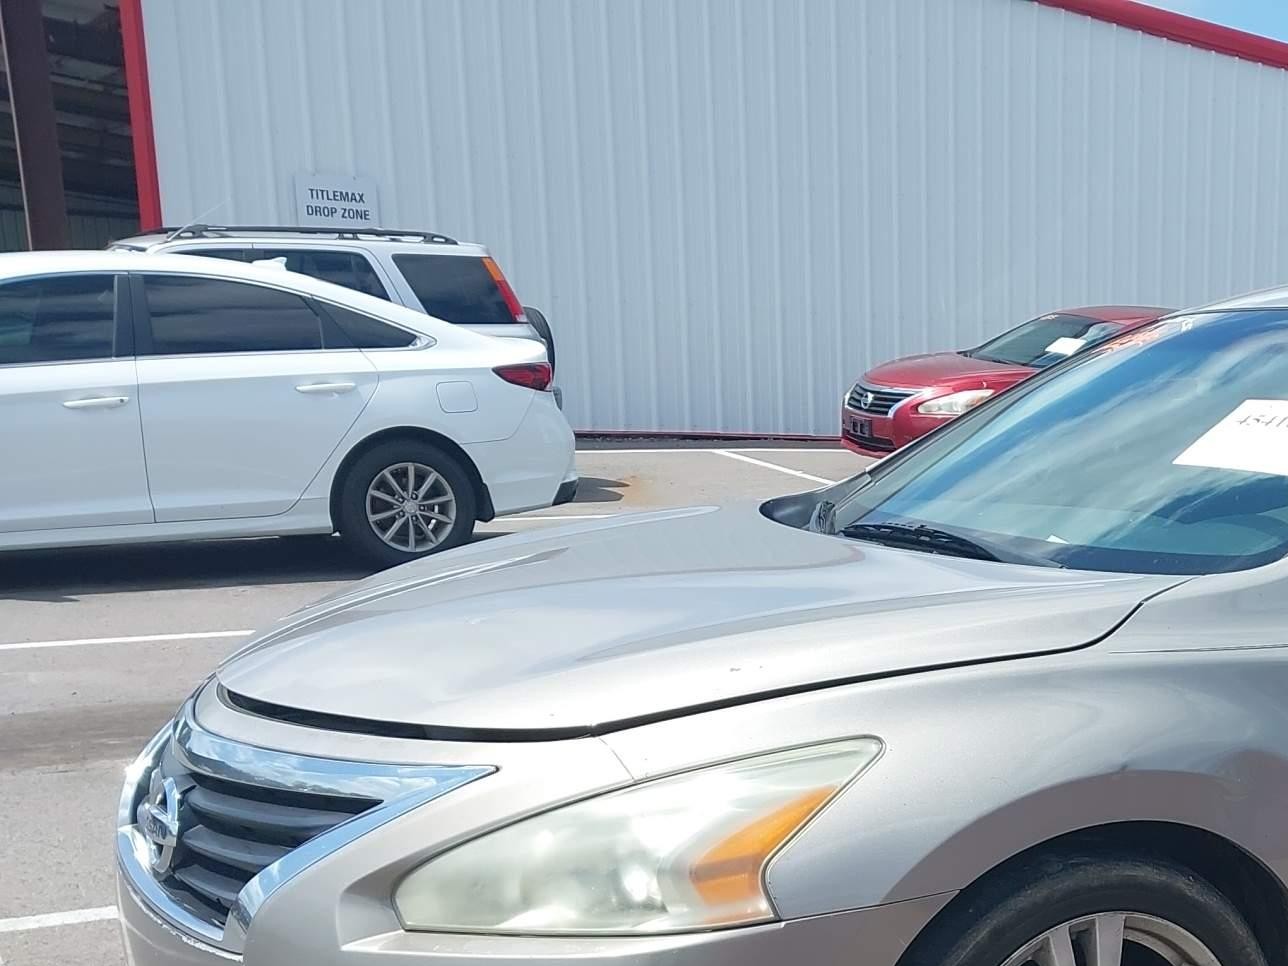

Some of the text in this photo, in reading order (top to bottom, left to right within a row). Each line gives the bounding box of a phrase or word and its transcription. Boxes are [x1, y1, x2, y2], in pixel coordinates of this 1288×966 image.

[308, 188, 365, 203] TITLEMAX
[306, 205, 370, 220] DROP ZONE
